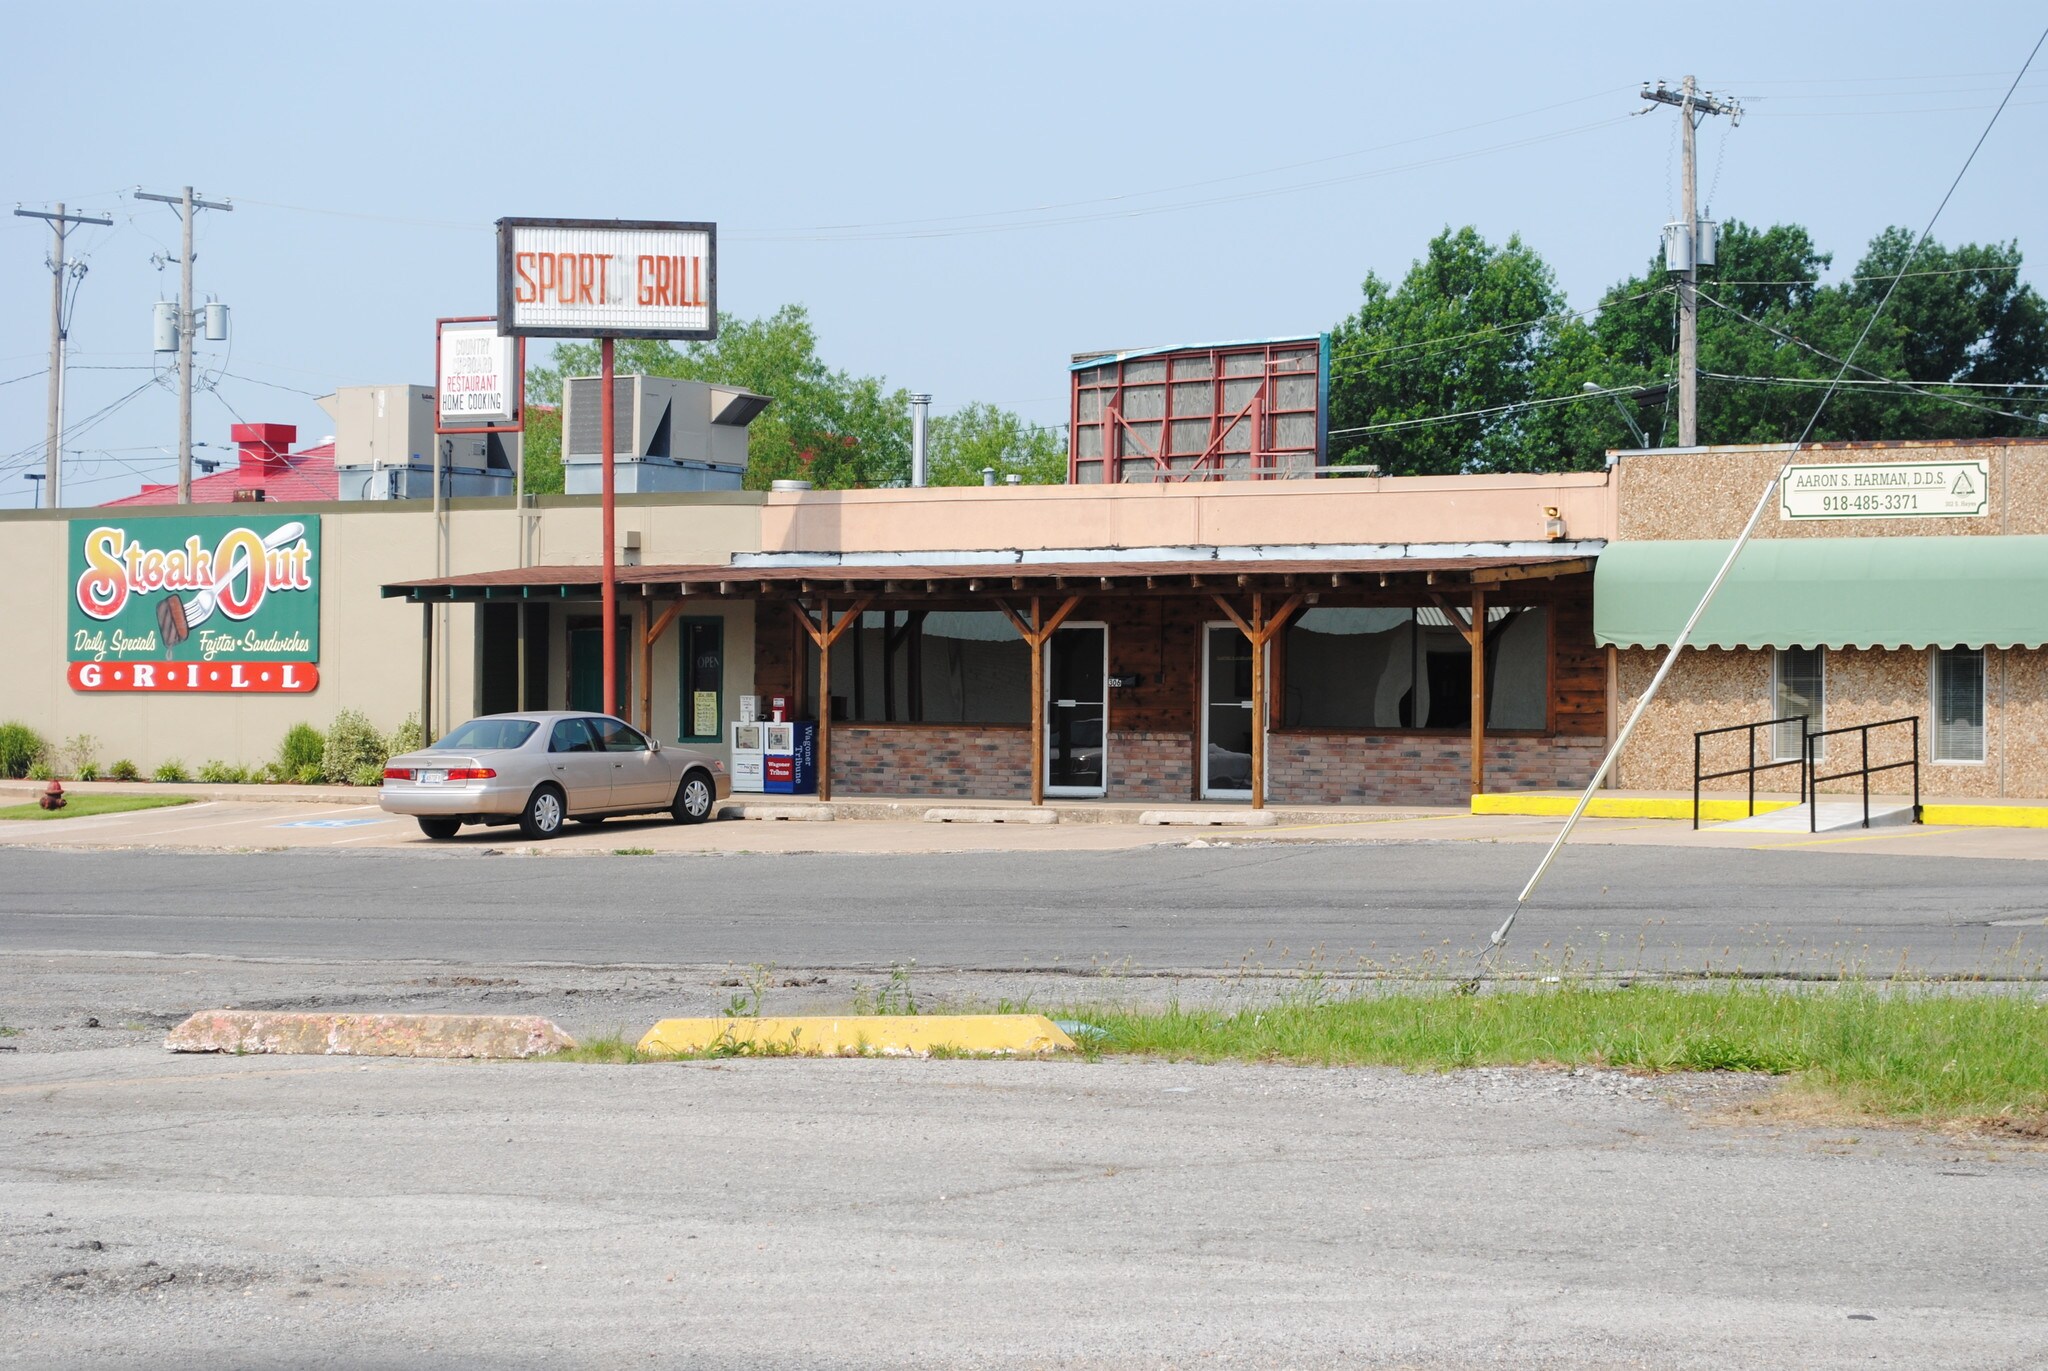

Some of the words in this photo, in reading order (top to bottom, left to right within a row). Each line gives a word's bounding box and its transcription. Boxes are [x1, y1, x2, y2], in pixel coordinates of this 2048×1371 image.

[515, 252, 614, 305] SPORT
[637, 254, 707, 306] GRILL
[456, 338, 491, 356] COUNTRY
[447, 375, 497, 393] RESTAURANT
[442, 394, 464, 411] HOME
[468, 392, 502, 410] COOKING
[1796, 473, 1838, 488] AARON
[1841, 473, 1851, 487] S.
[1854, 471, 1911, 488] HARMAN,
[1914, 471, 1946, 486] D.D.S.
[1823, 494, 1918, 511] 918-485-3371
[77, 526, 214, 620] Steak
[213, 527, 312, 620] Out
[74, 629, 106, 662] Daily
[110, 629, 156, 658] Specials
[697, 655, 719, 669] OPEN
[1108, 679, 1121, 687] 306
[803, 726, 812, 766] Wagoner
[794, 746, 802, 784] Tribune
